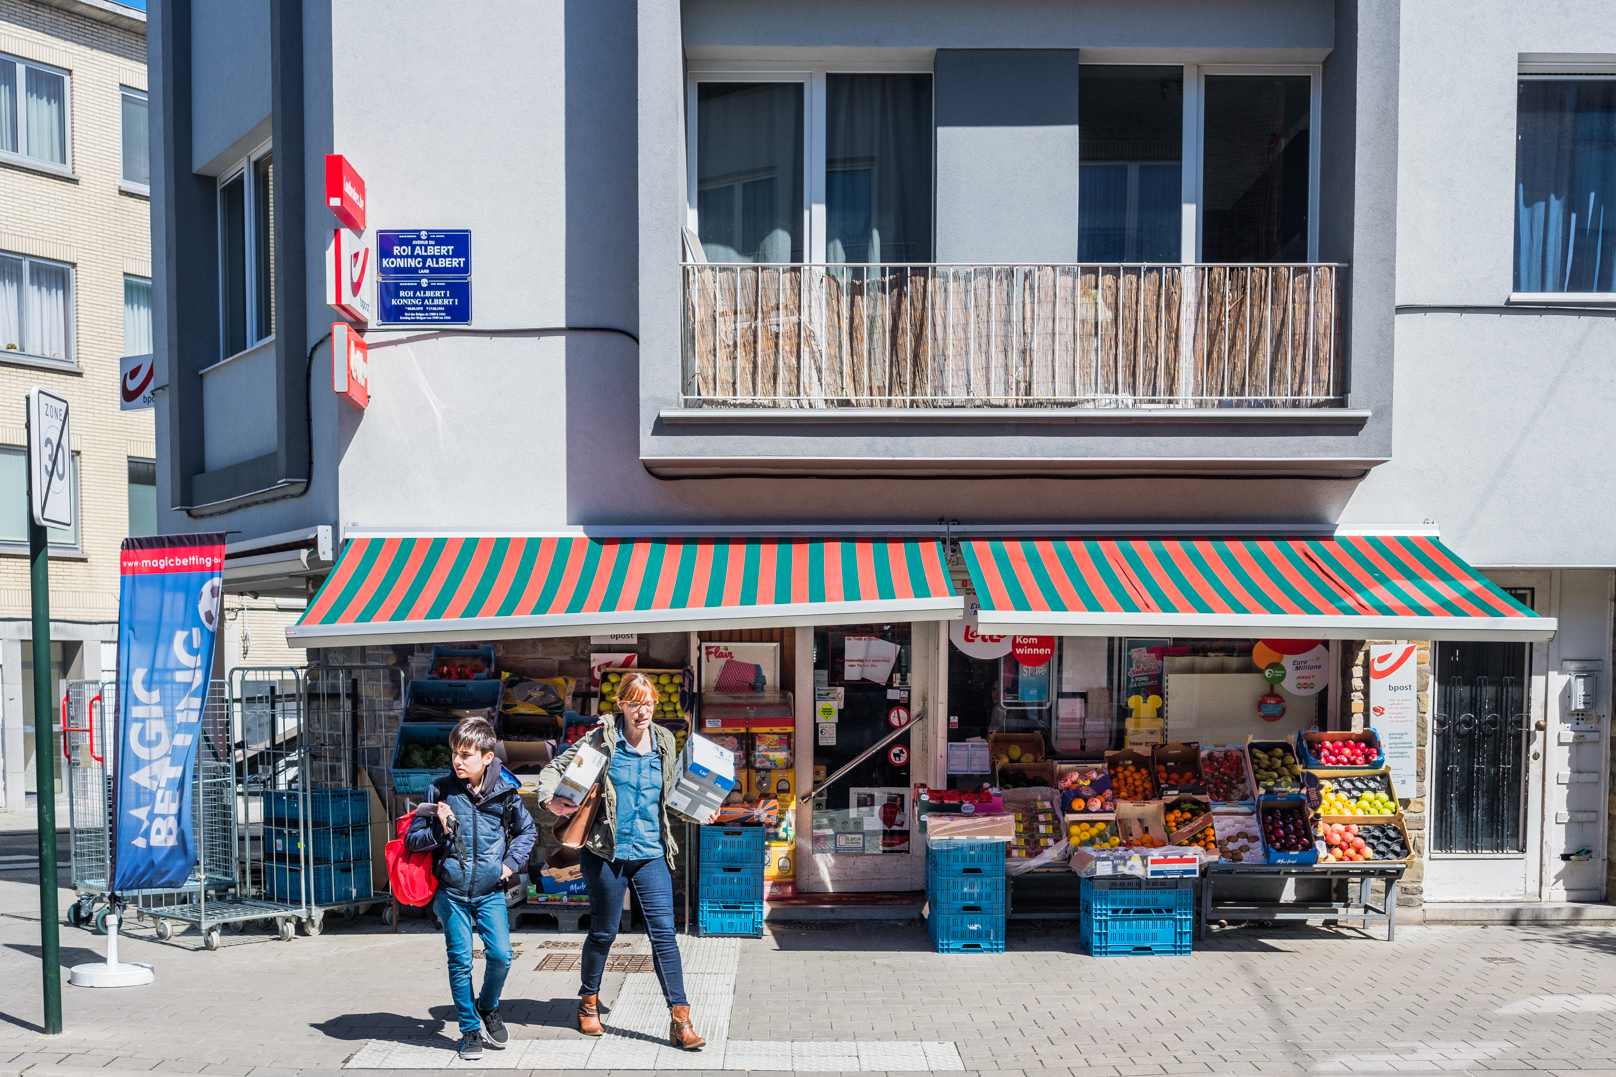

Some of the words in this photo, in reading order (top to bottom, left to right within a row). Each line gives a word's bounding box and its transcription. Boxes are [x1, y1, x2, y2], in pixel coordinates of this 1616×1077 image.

[394, 246, 411, 256] ROI
[414, 246, 454, 256] ALBERT
[382, 258, 423, 268] KONING
[425, 258, 466, 268] ALBERT
[143, 395, 155, 406] bpo
[44, 402, 62, 422] ZONE
[44, 437, 66, 481] 30
[705, 646, 734, 663] Flair
[1016, 646, 1050, 654] winnen
[150, 627, 203, 847] BETTING
